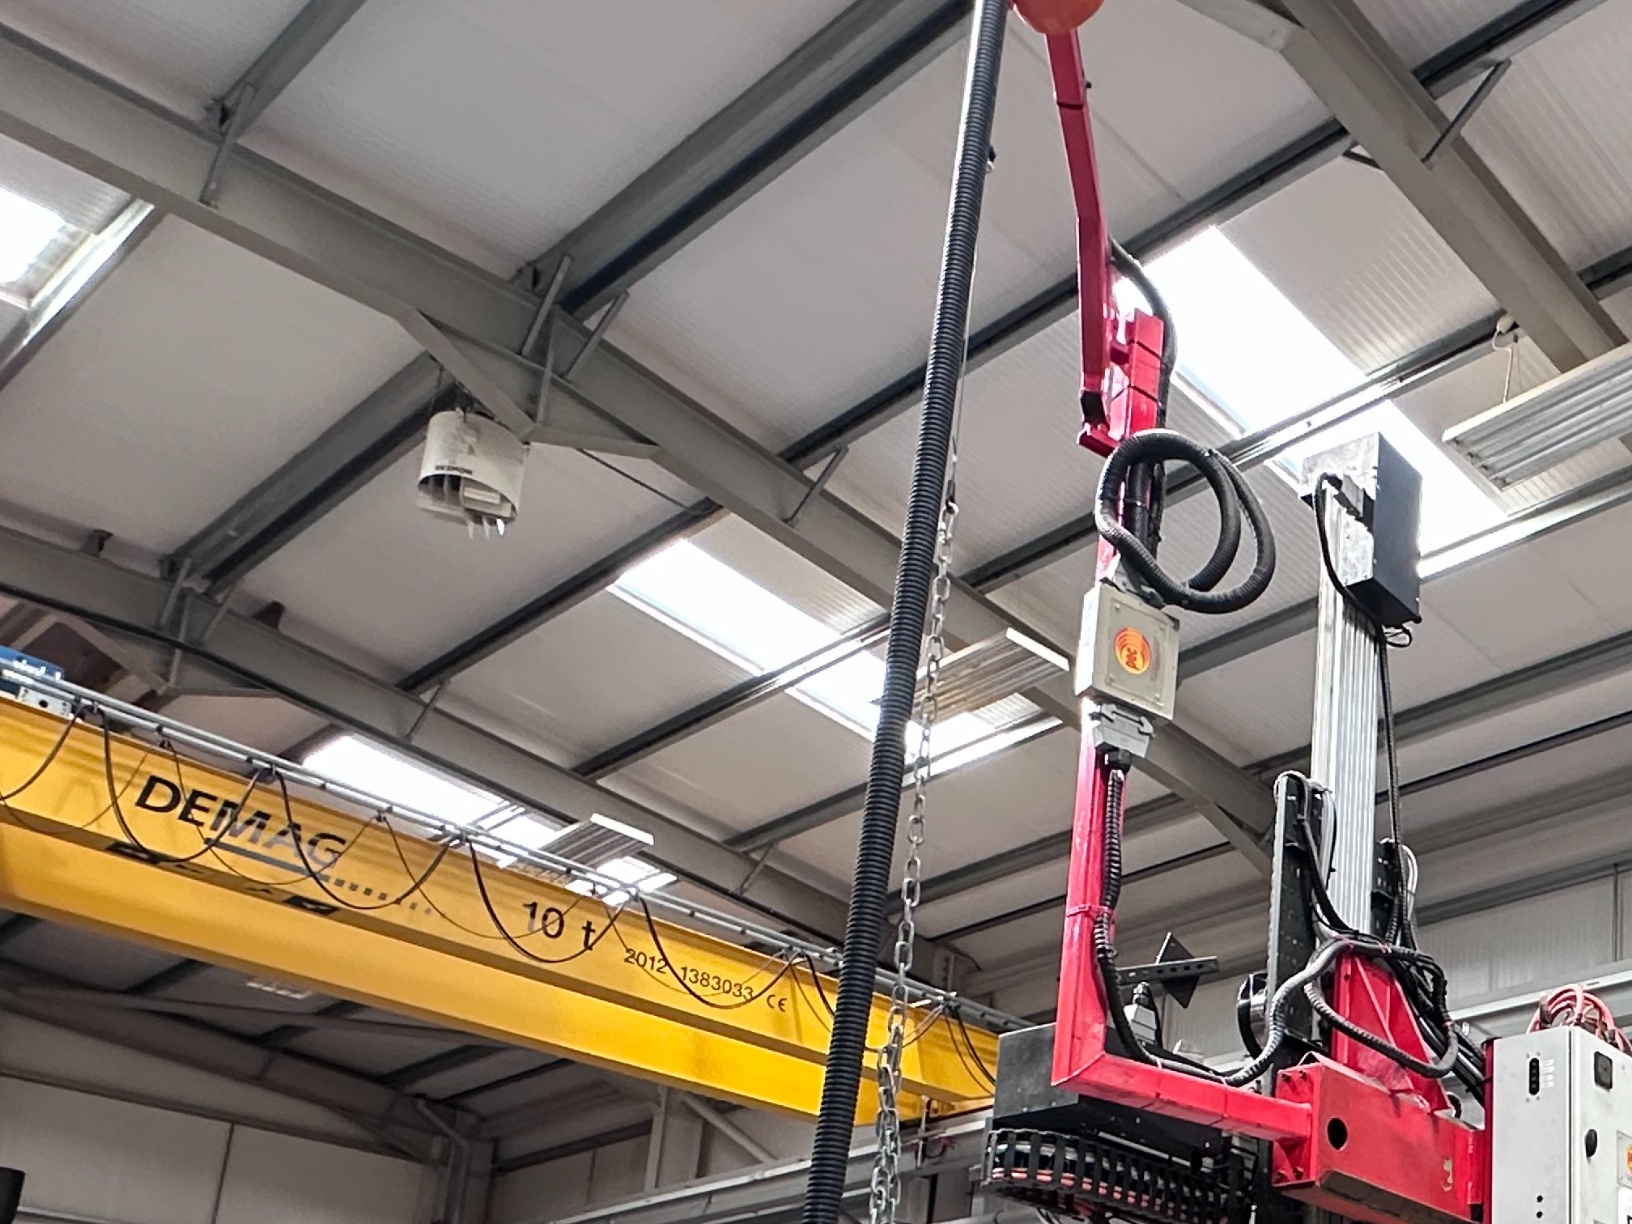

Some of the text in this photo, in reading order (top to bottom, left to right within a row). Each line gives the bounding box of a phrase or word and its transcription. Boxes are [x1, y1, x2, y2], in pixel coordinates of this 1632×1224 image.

[134, 774, 347, 869] DEMAG
[522, 900, 596, 951] 10 t
[624, 947, 669, 975] 2012
[680, 966, 754, 1000] 1383033
